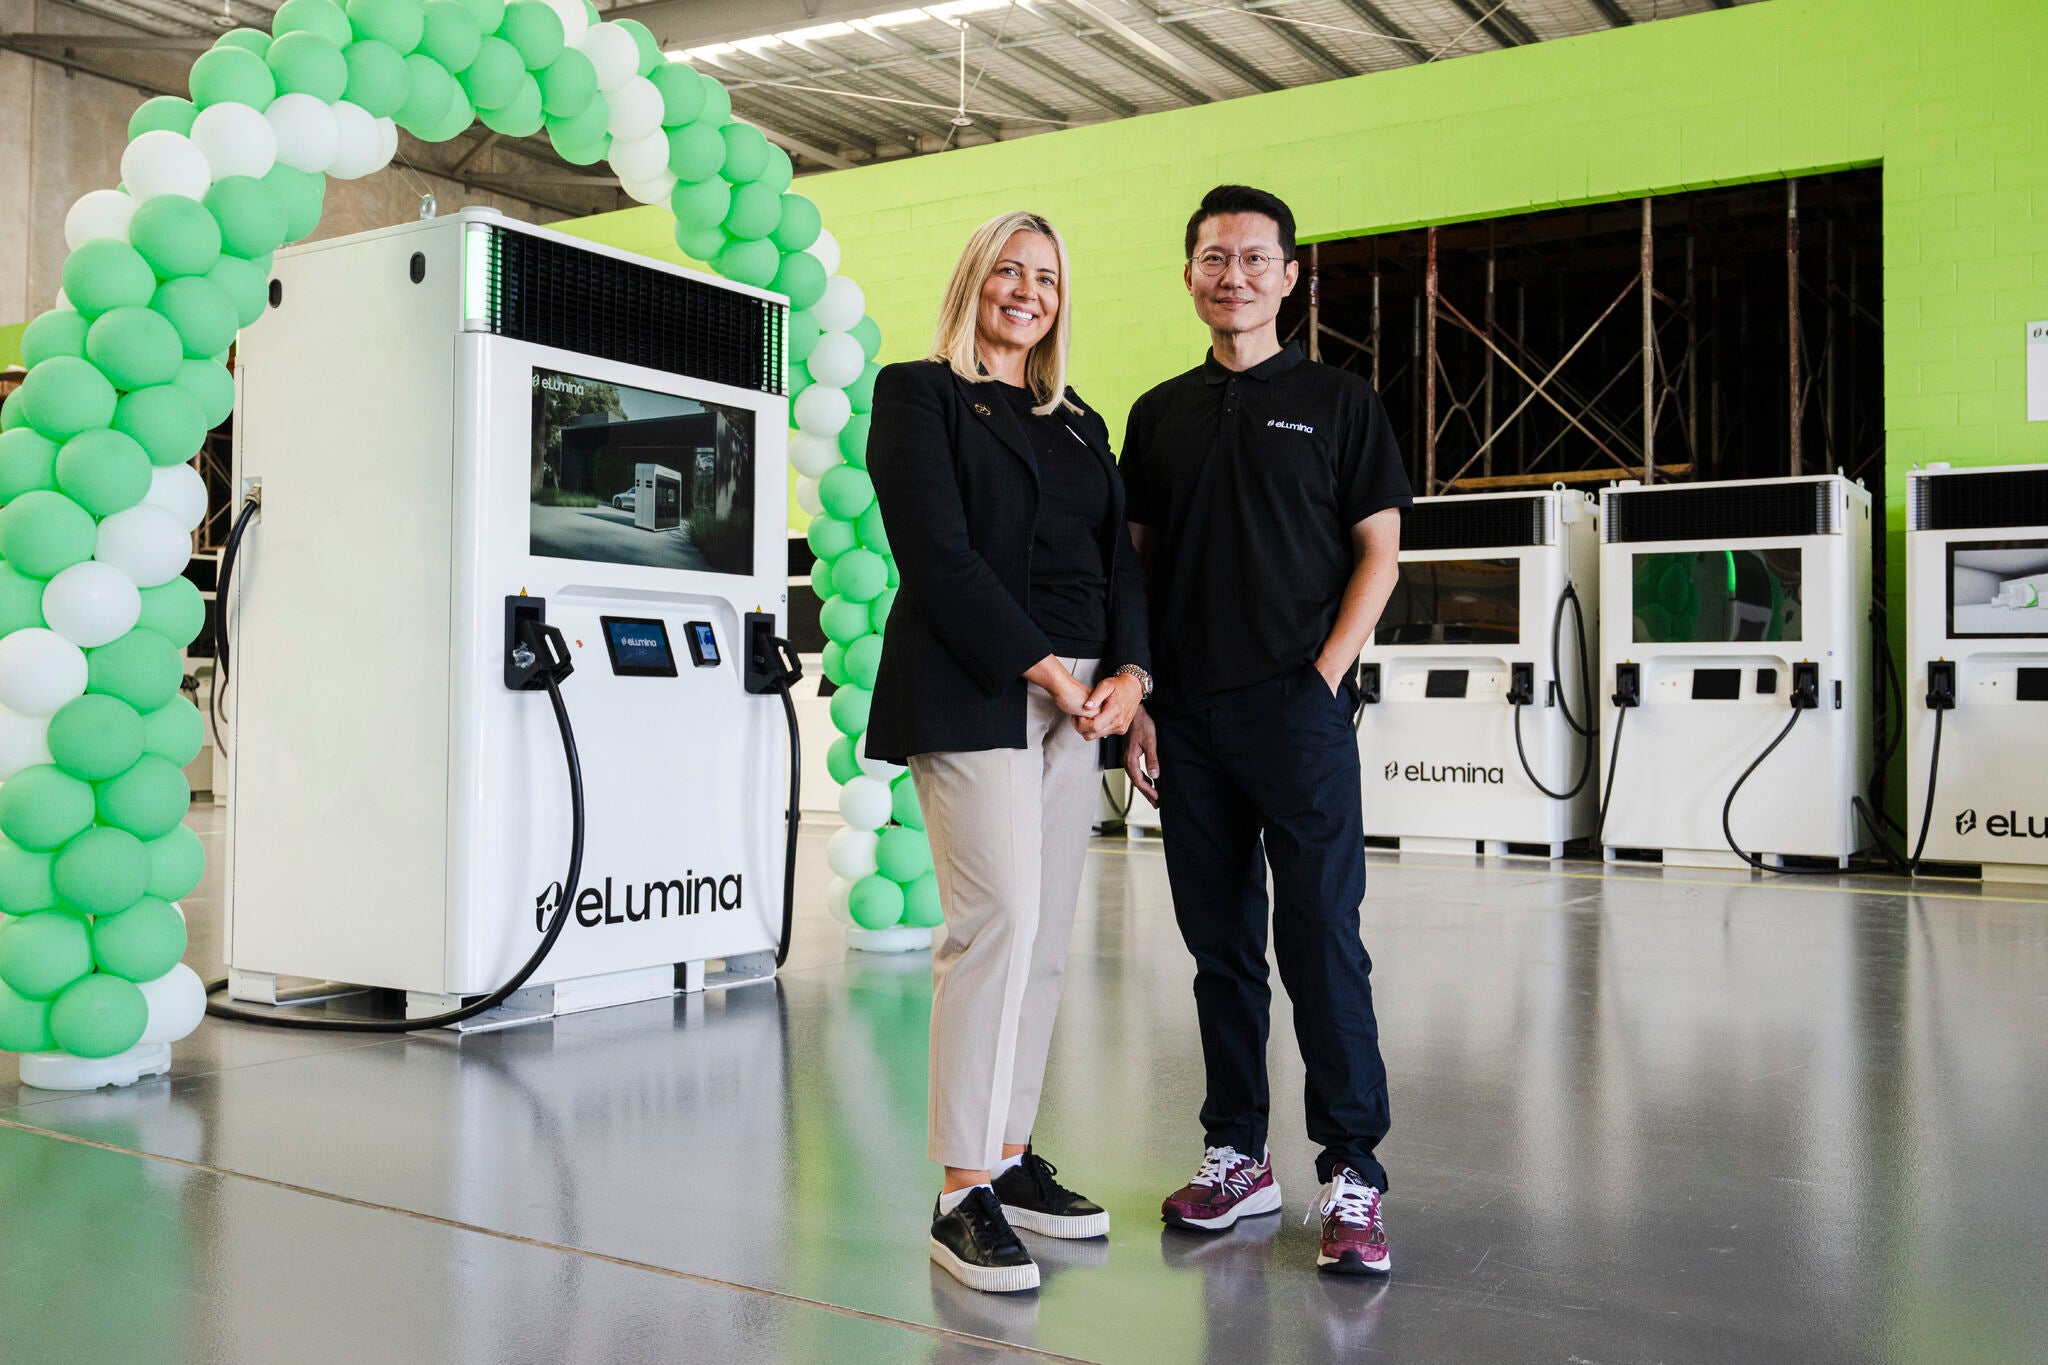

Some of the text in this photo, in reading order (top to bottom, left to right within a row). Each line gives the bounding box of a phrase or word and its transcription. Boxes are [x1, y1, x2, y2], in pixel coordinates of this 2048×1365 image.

[541, 377, 584, 396] eLumina
[1275, 421, 1313, 433] eLumina
[1404, 761, 1504, 784] eLumina
[1986, 810, 2048, 838] eLu
[575, 869, 742, 928] eLumina
